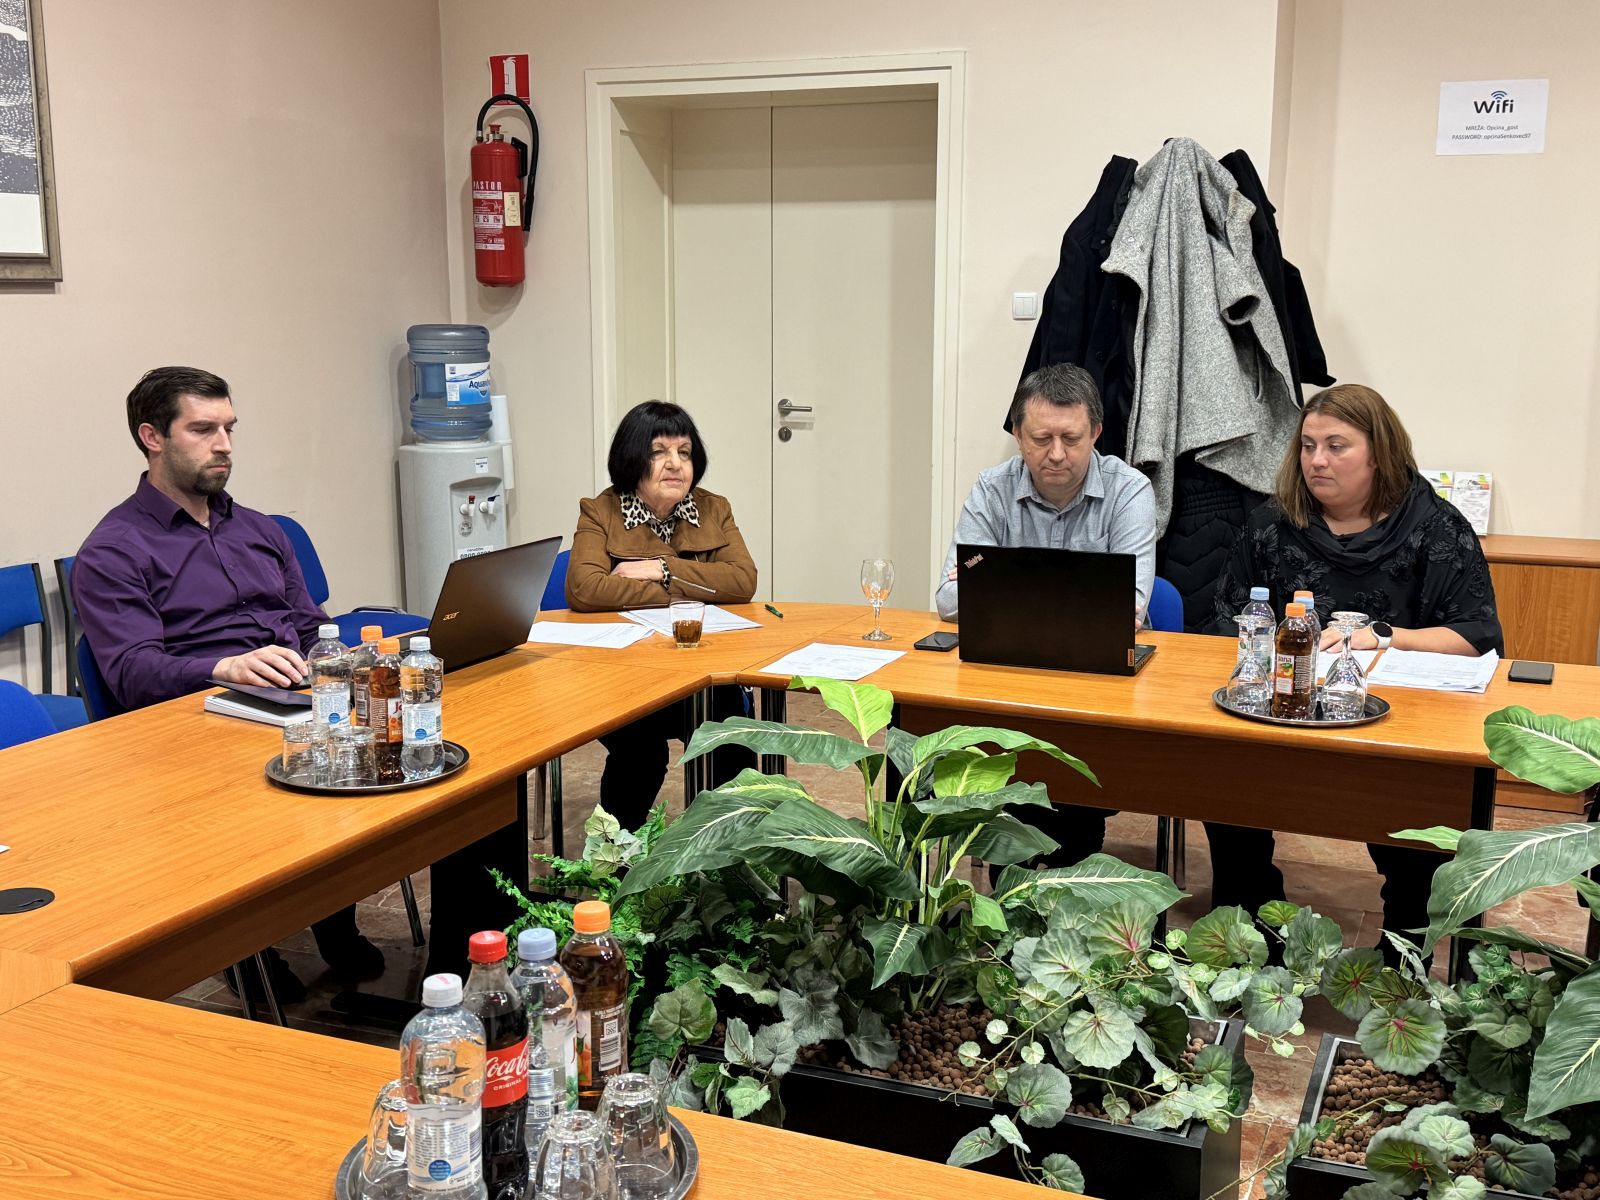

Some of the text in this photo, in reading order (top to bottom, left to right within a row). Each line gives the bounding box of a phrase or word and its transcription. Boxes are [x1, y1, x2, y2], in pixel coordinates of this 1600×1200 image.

[1473, 99, 1515, 114] Wifi
[443, 611, 460, 621] acer
[493, 1078, 522, 1091] ORIGINAL
